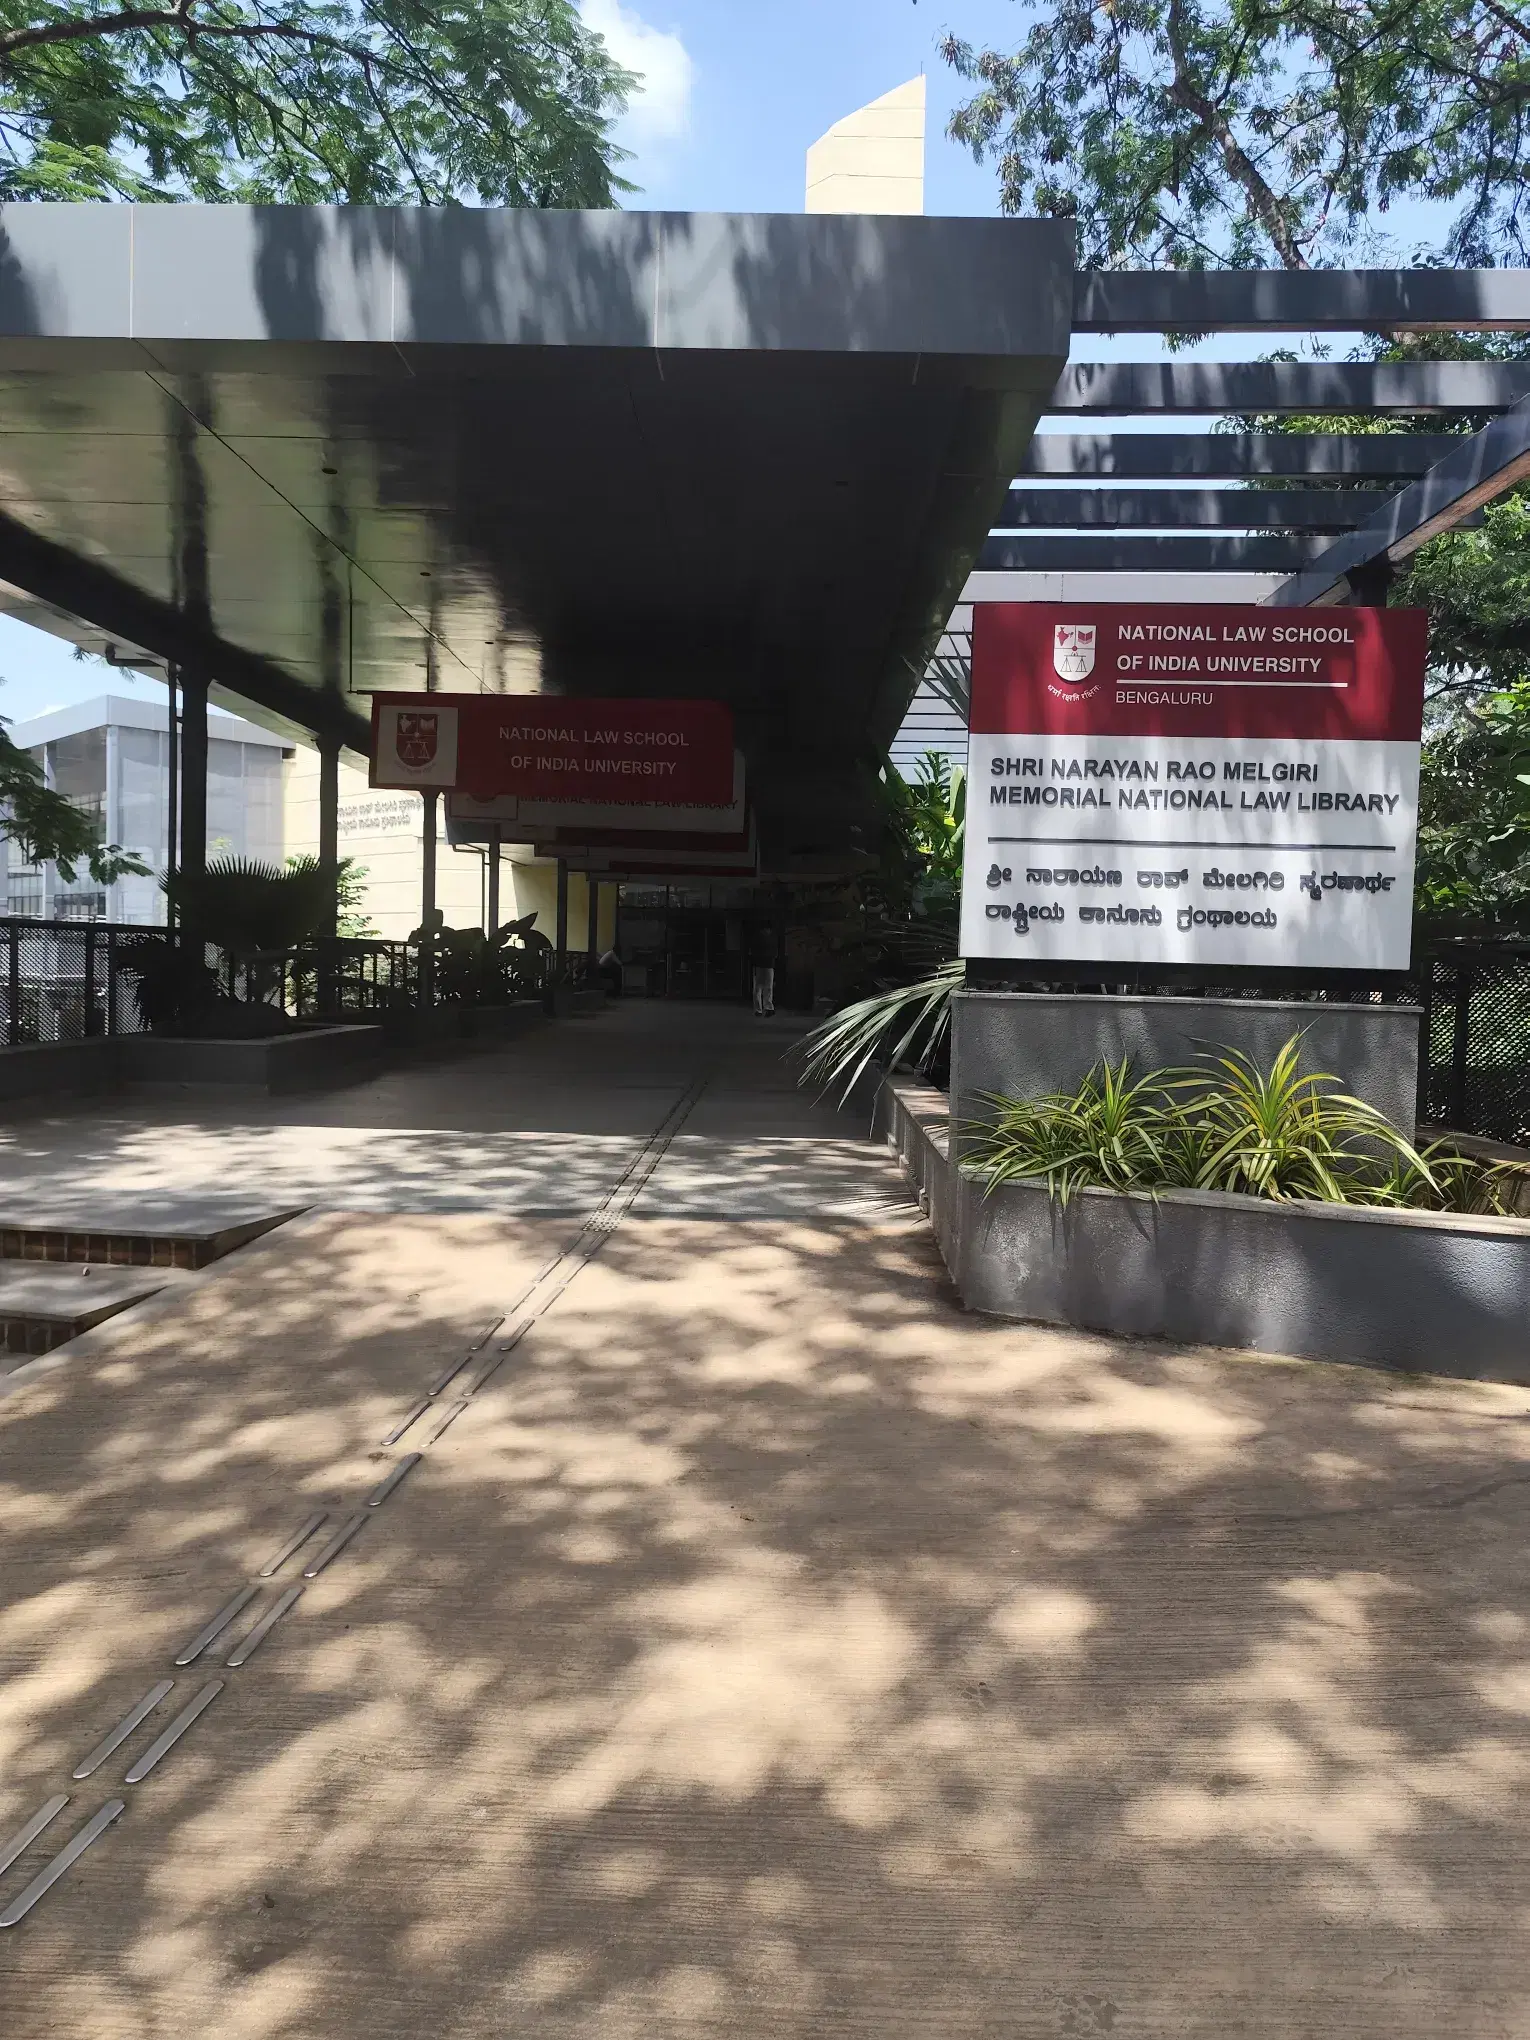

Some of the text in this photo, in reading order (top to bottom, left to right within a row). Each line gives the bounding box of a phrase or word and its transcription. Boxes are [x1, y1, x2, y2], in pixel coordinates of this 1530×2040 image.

[1118, 625, 1354, 643] NATIONAL LAW SCHOOL
[1116, 655, 1322, 673] OF INDIA UNIVERSITY
[1115, 691, 1214, 705] BENGALURU
[499, 727, 690, 747] NATIONAL LAW SCHOOL
[511, 755, 677, 775] OF INDIA UNIVERSITY
[990, 757, 1318, 783] SHRI NARAYAN RAO MELGIRI
[990, 785, 1400, 815] MEMORIAL NATIONAL LAW LIBRARY
[986, 863, 1012, 888] ಶ್ರೀ
[1026, 865, 1123, 887] ನಾರಾಯಣ
[1136, 868, 1189, 888] ರಾವ್
[1202, 867, 1285, 890] ಮೇಲಗಿರಿ
[1079, 903, 1163, 925] ಕಾನೂನು
[1176, 904, 1278, 932] ಗ್ರಂಥಾಲಯ
